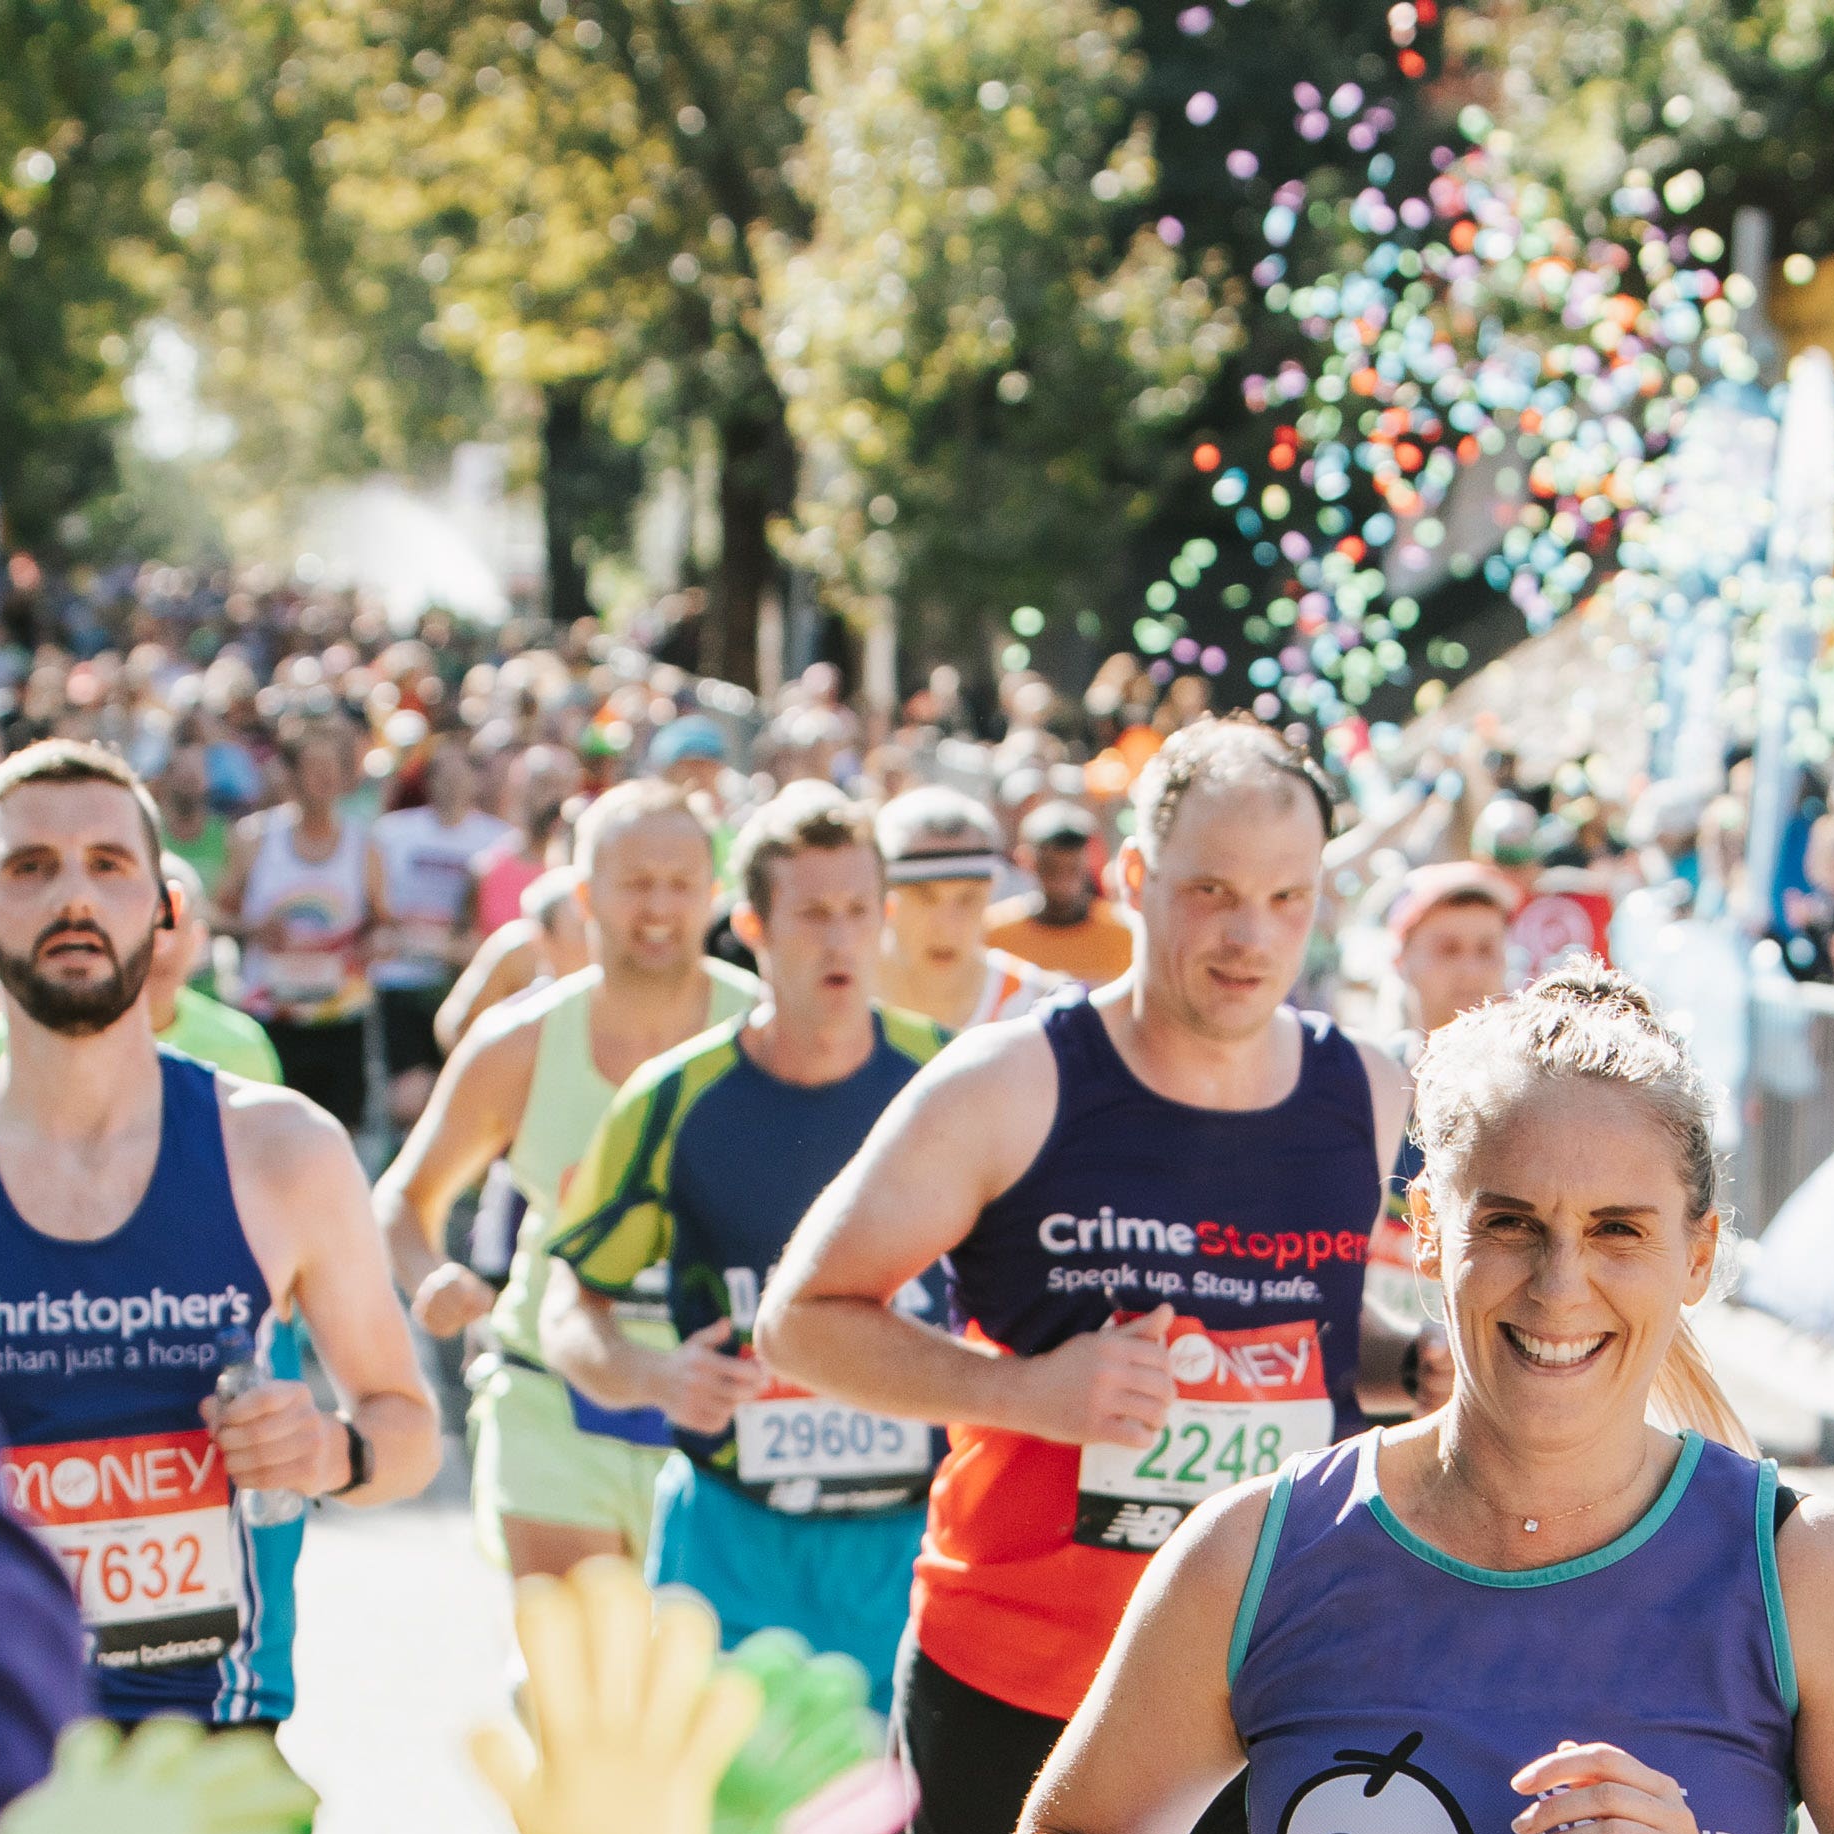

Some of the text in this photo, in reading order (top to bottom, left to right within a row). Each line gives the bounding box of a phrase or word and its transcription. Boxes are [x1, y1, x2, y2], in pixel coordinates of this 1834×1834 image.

[1038, 1206, 1368, 1270] CrimeStopper
[1047, 1263, 1322, 1305] Speak up. Stay safe.
[64, 1345, 114, 1375] just
[124, 1346, 141, 1366] a
[148, 1338, 215, 1370] hosp
[1169, 1333, 1309, 1386] ONEY
[764, 1411, 904, 1461] 29605
[1134, 1421, 1282, 1483] 2248
